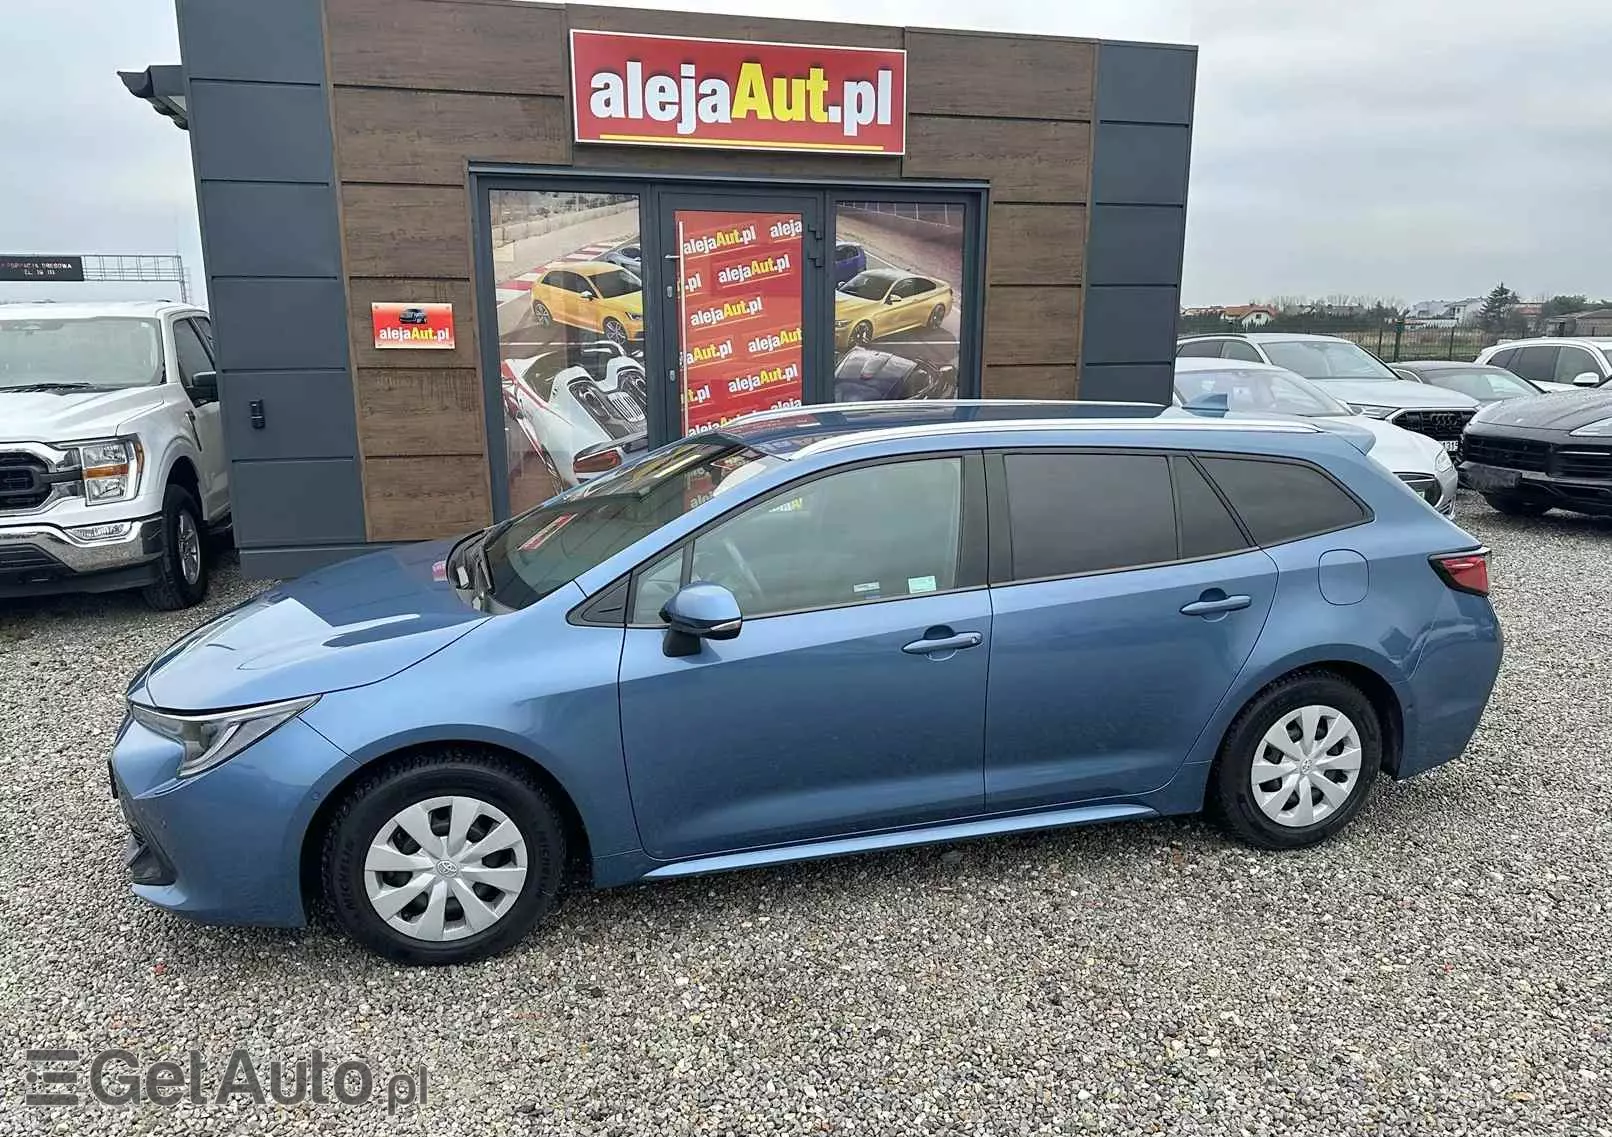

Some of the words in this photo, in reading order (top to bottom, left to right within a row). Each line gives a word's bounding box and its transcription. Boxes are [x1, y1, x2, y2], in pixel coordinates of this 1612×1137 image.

[589, 60, 892, 137] alejaAut.pl
[683, 224, 757, 254] alejaAut.pl
[717, 253, 791, 283] alejaAut.pl
[690, 296, 763, 327] alejaAut.pl
[379, 326, 450, 342] alejaAut.pl
[728, 363, 799, 393] alejaAut.pl
